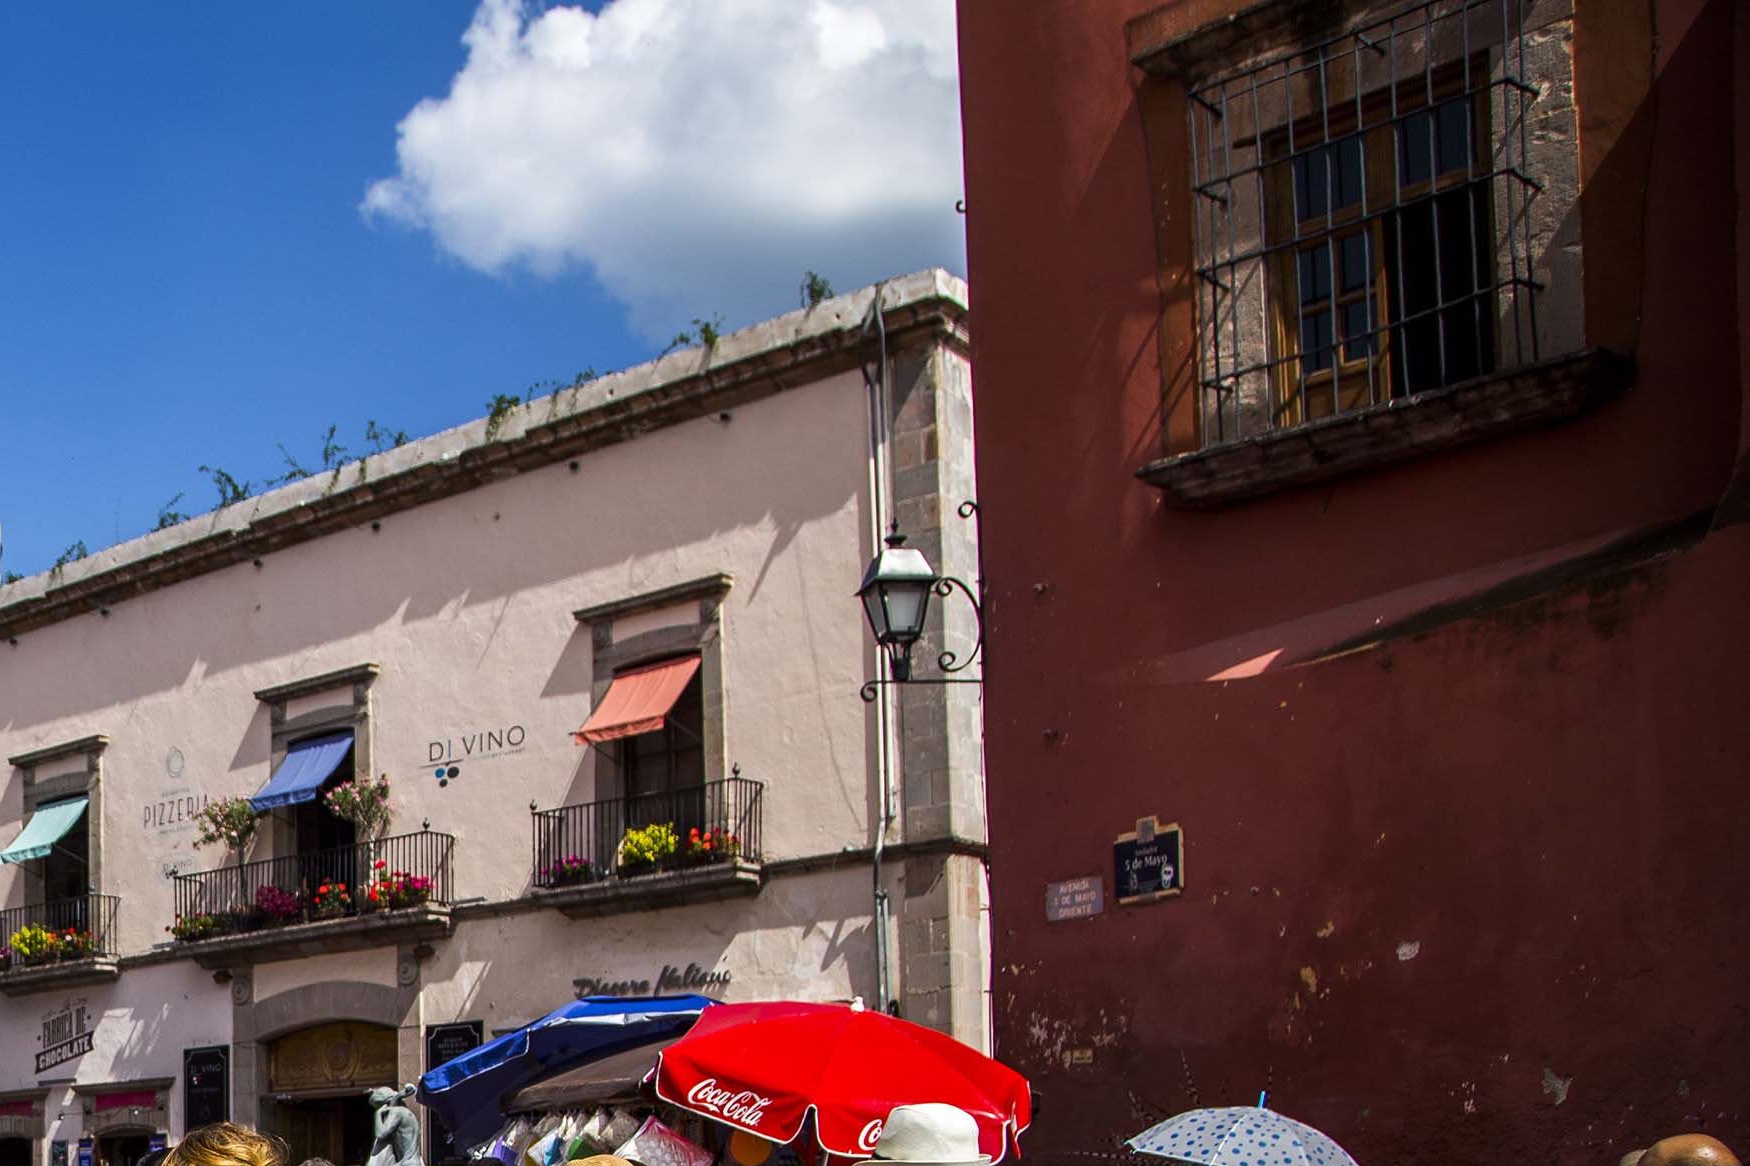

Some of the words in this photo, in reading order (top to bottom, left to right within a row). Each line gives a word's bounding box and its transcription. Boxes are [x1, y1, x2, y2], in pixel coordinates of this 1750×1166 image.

[429, 740, 451, 762] DI
[462, 725, 525, 755] VINO
[143, 794, 210, 829] PIZZERIA
[1132, 858, 1142, 869] de
[1144, 854, 1168, 868] Mayo
[38, 1035, 91, 1070] CHOCOLATE
[687, 1078, 773, 1127] Coca-Cola
